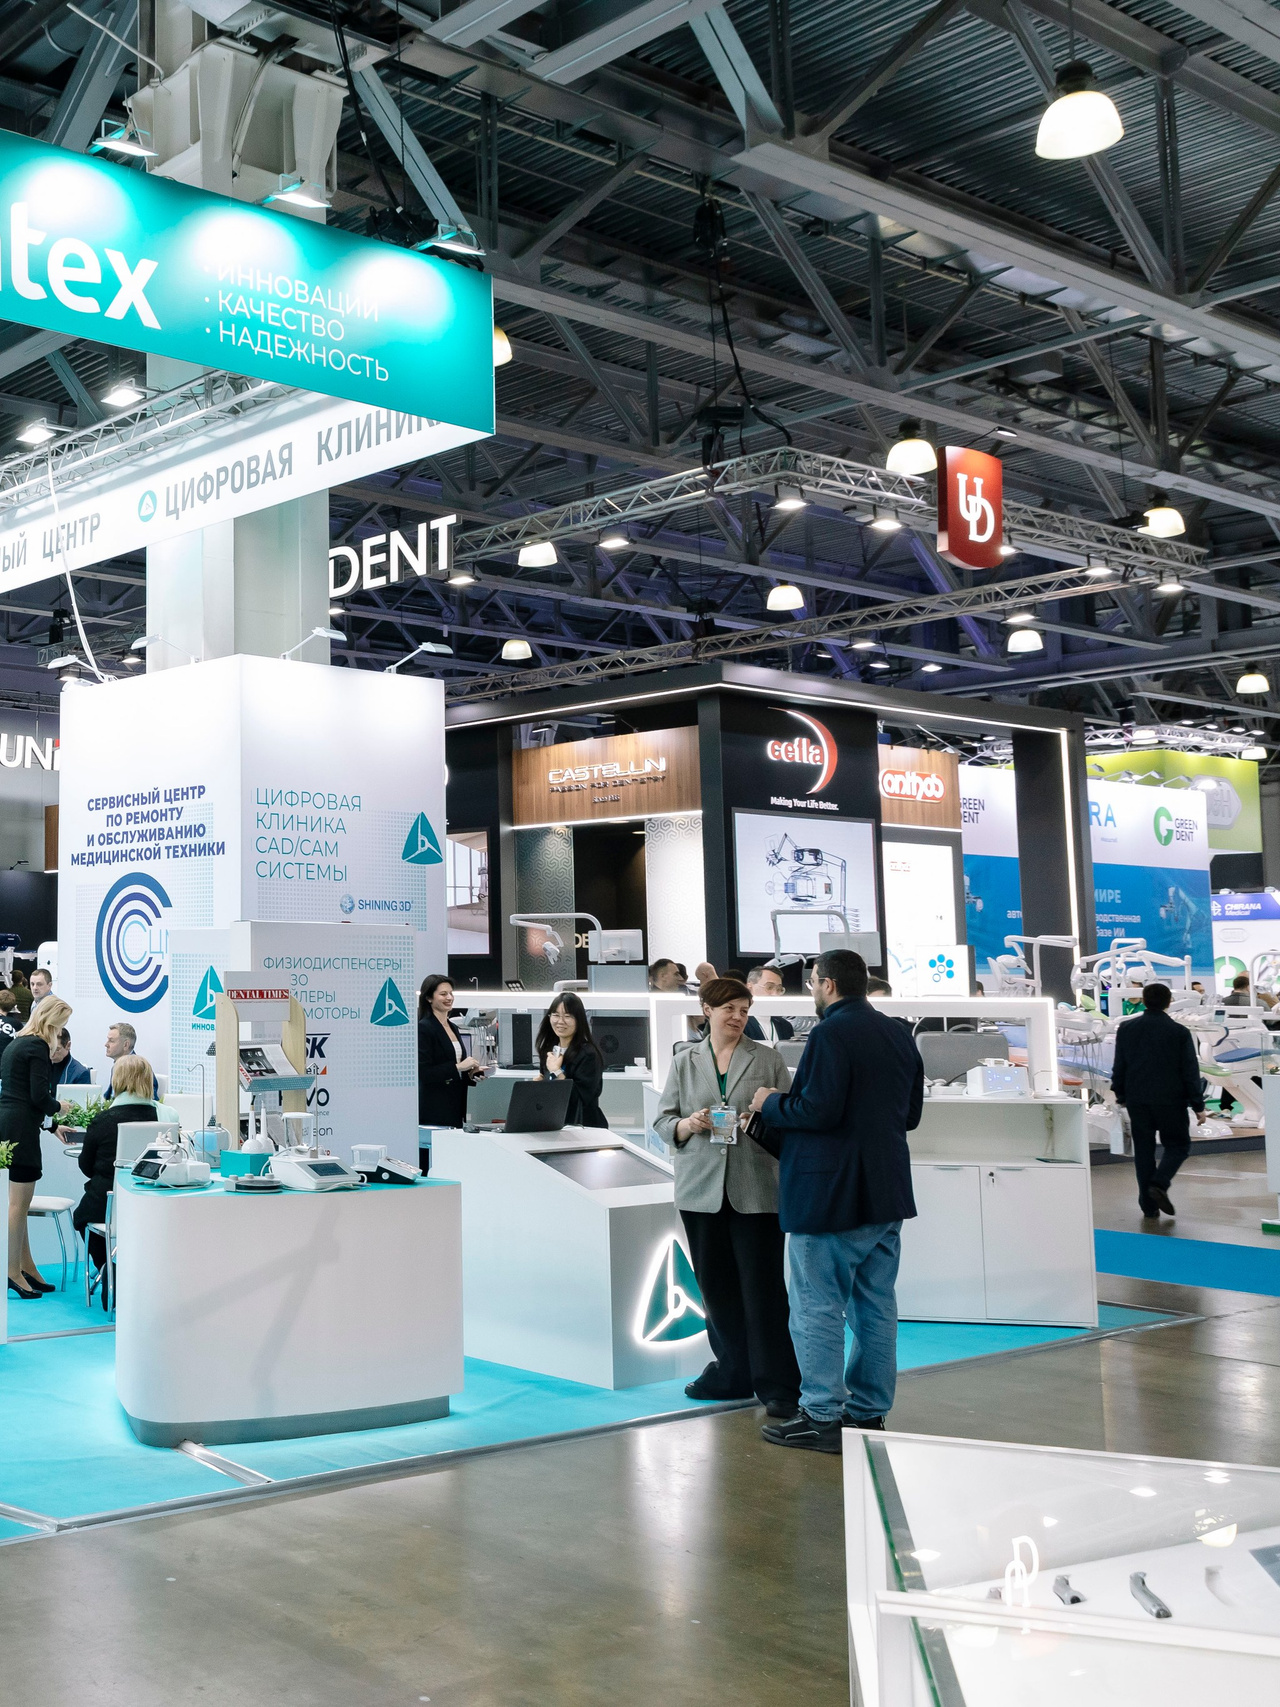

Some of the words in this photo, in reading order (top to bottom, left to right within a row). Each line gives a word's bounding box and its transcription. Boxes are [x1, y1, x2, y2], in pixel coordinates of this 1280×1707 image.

[219, 262, 379, 322] ИННОВАЦИИ
[219, 290, 345, 341] КАЧЕСТВО
[220, 321, 389, 382] НАДЕЖНОСТЬ
[165, 441, 293, 519] ЦИФРОВАЯ
[317, 409, 442, 466] КЛИНИ
[43, 512, 101, 563] ЦЕНТР
[329, 513, 461, 598] DENT
[768, 737, 823, 765] cefla
[87, 787, 159, 812] СЕРВИСНЫЙ
[164, 785, 206, 807] ЦЕНТР
[256, 787, 361, 812] ЦИФРОВАЯ
[770, 796, 792, 809] Making
[793, 798, 806, 808] Your
[807, 799, 818, 809] Life
[106, 813, 123, 828] ПО
[125, 806, 184, 827] РЕМОНТУ
[256, 812, 347, 835] КЛИНИКА
[1089, 801, 1117, 828] RA
[1174, 818, 1198, 831] GREEN
[87, 834, 95, 847] И
[98, 823, 206, 847] ОБСЛУЖИВАНИЮ
[1175, 830, 1194, 842] DENT
[71, 844, 162, 867] МЕДИЦИНСКОЙ
[165, 841, 226, 861] ТЕХНИКИ
[256, 836, 339, 858] CAD/CAM
[255, 860, 348, 882] СИСТЕМЫ
[358, 898, 397, 912] SHINING
[399, 899, 413, 912] 3D
[1224, 903, 1262, 911] CHIRANA
[1096, 912, 1141, 924] водственная
[1114, 928, 1126, 937] ИИ
[263, 957, 402, 972] ФИЗИОДИСПЕНСЕРЫ
[290, 974, 309, 986] ЗО
[228, 989, 261, 999] DENTAL
[261, 989, 290, 999] TIMES
[290, 987, 336, 1003] ЙЛЕРЫ
[305, 1006, 360, 1019] МОТОРЫ
[191, 1023, 216, 1031] ИННОВ
